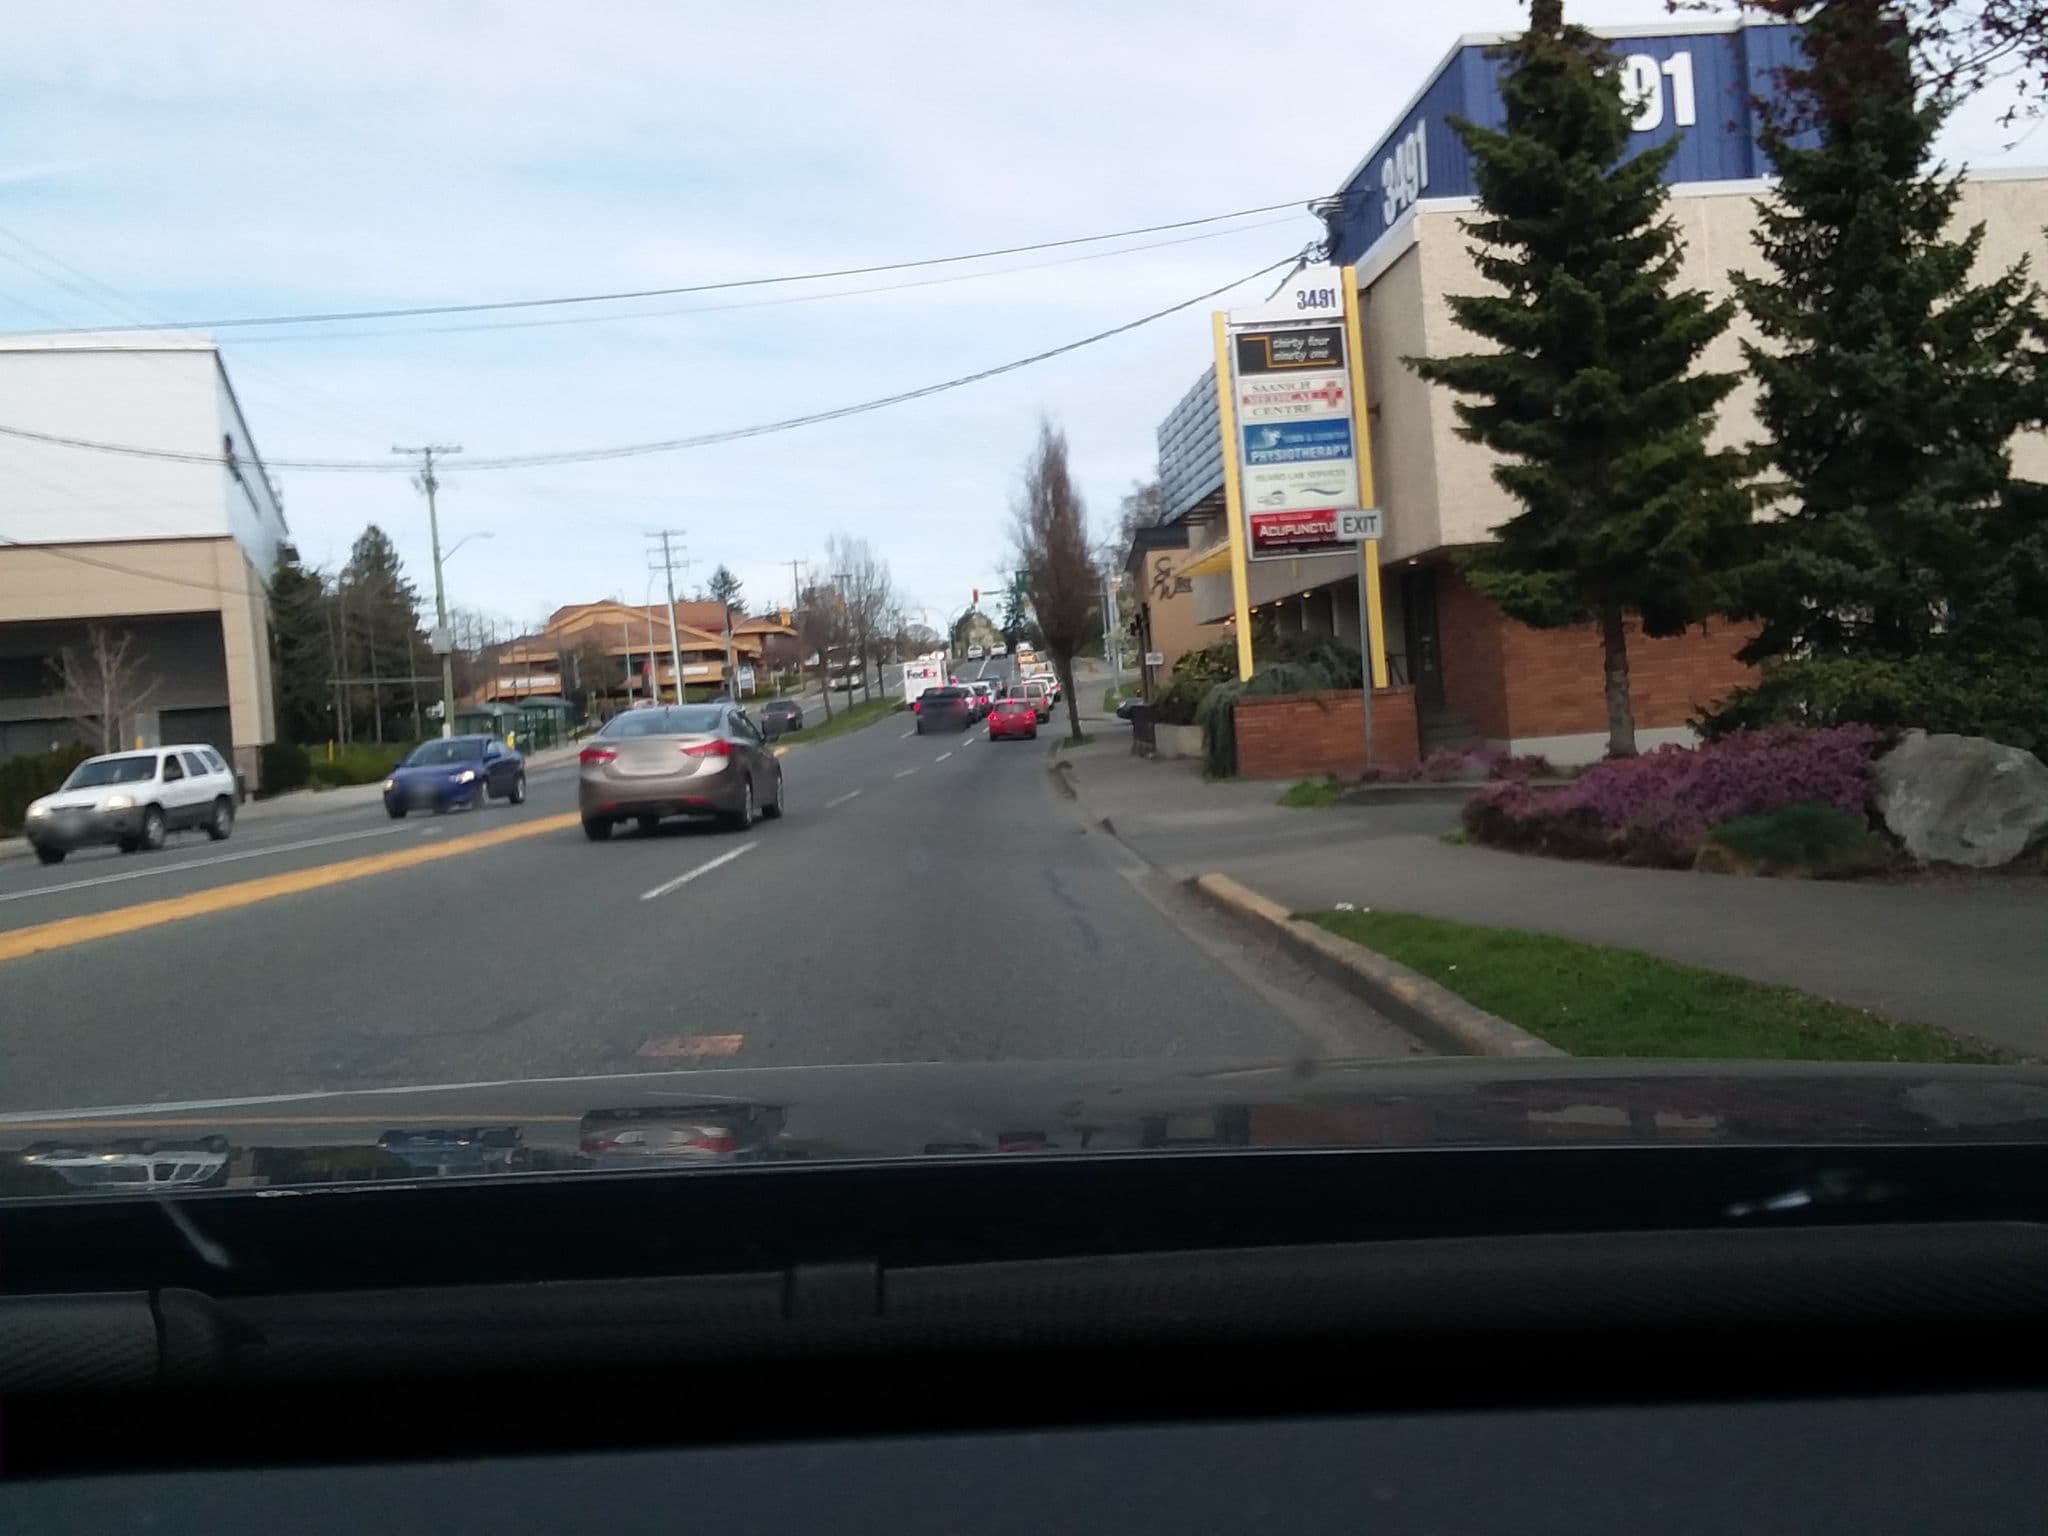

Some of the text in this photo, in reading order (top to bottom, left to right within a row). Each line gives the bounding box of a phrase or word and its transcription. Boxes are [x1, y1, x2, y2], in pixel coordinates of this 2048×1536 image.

[1620, 51, 1697, 132] 91
[1381, 119, 1429, 227] 3491
[1296, 288, 1337, 310] 3491
[1252, 405, 1312, 417] CENTRE
[1250, 444, 1349, 463] PHYSIOTHERAPY
[1259, 522, 1336, 537] ACUPUNCTU
[1343, 515, 1377, 534] EXIT
[906, 668, 938, 680] FedEx
